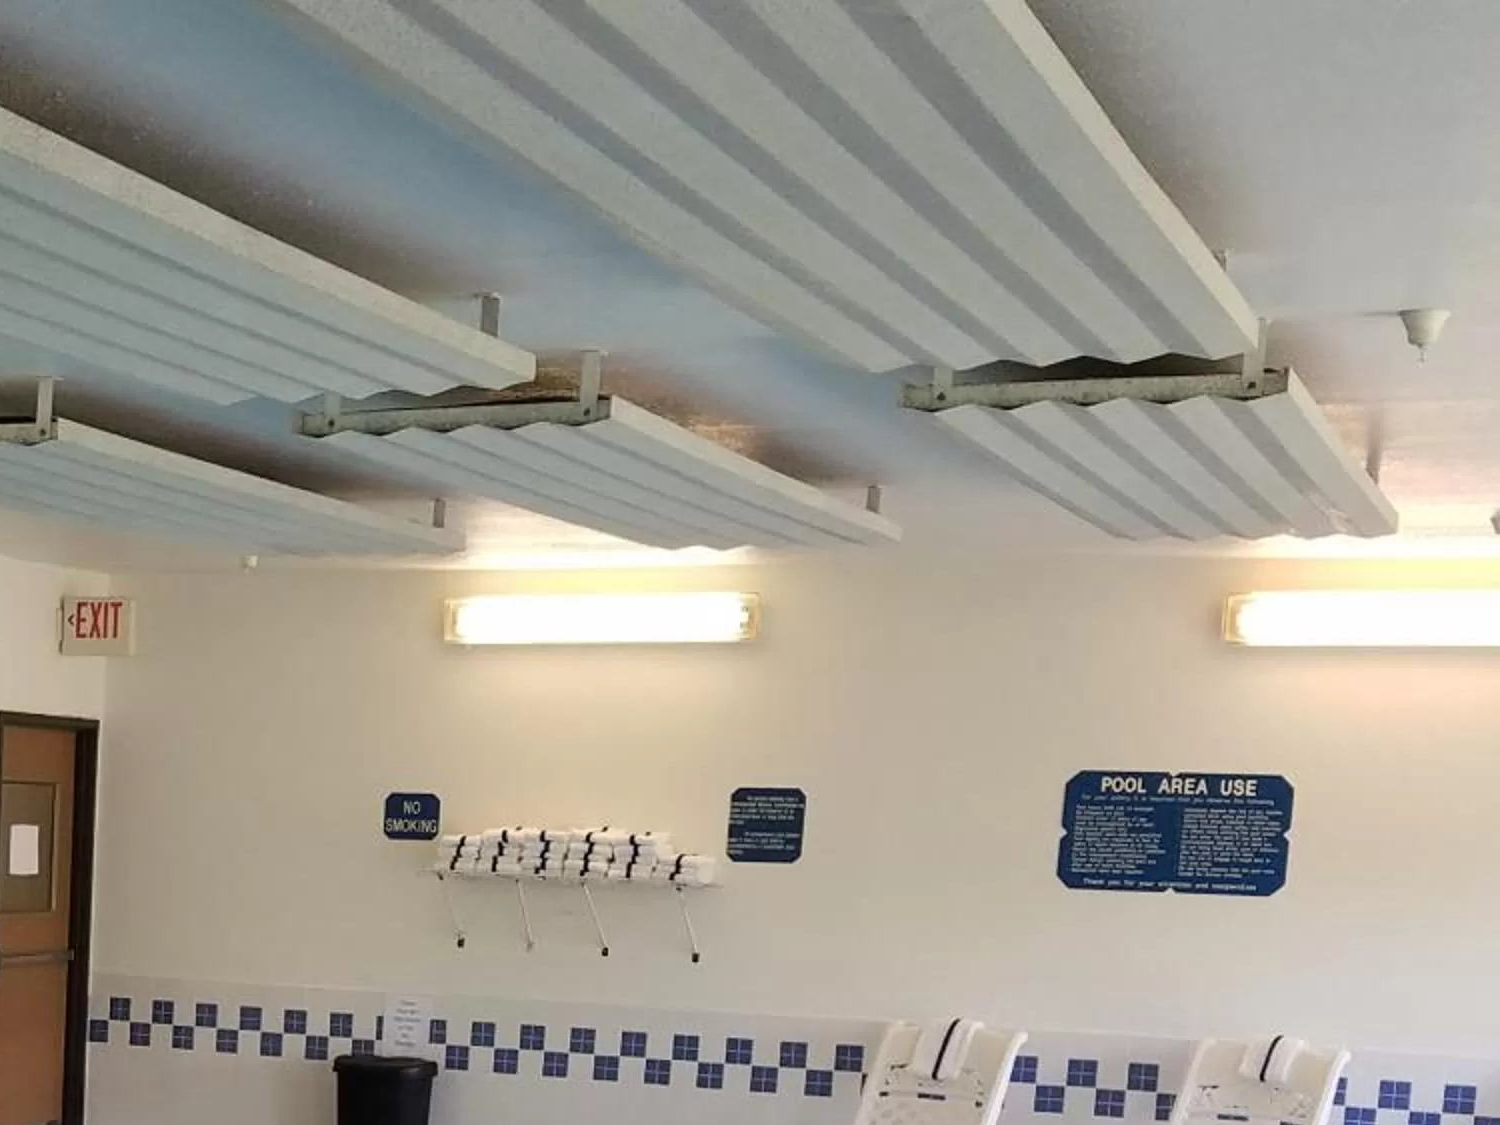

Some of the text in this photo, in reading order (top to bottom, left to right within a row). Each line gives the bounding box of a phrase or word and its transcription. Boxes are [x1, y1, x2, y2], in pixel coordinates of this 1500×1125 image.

[76, 601, 123, 639] EXIT
[1101, 776, 1258, 797] POOL AREA USE
[403, 801, 421, 815] NO
[386, 818, 437, 833] SMOKING
